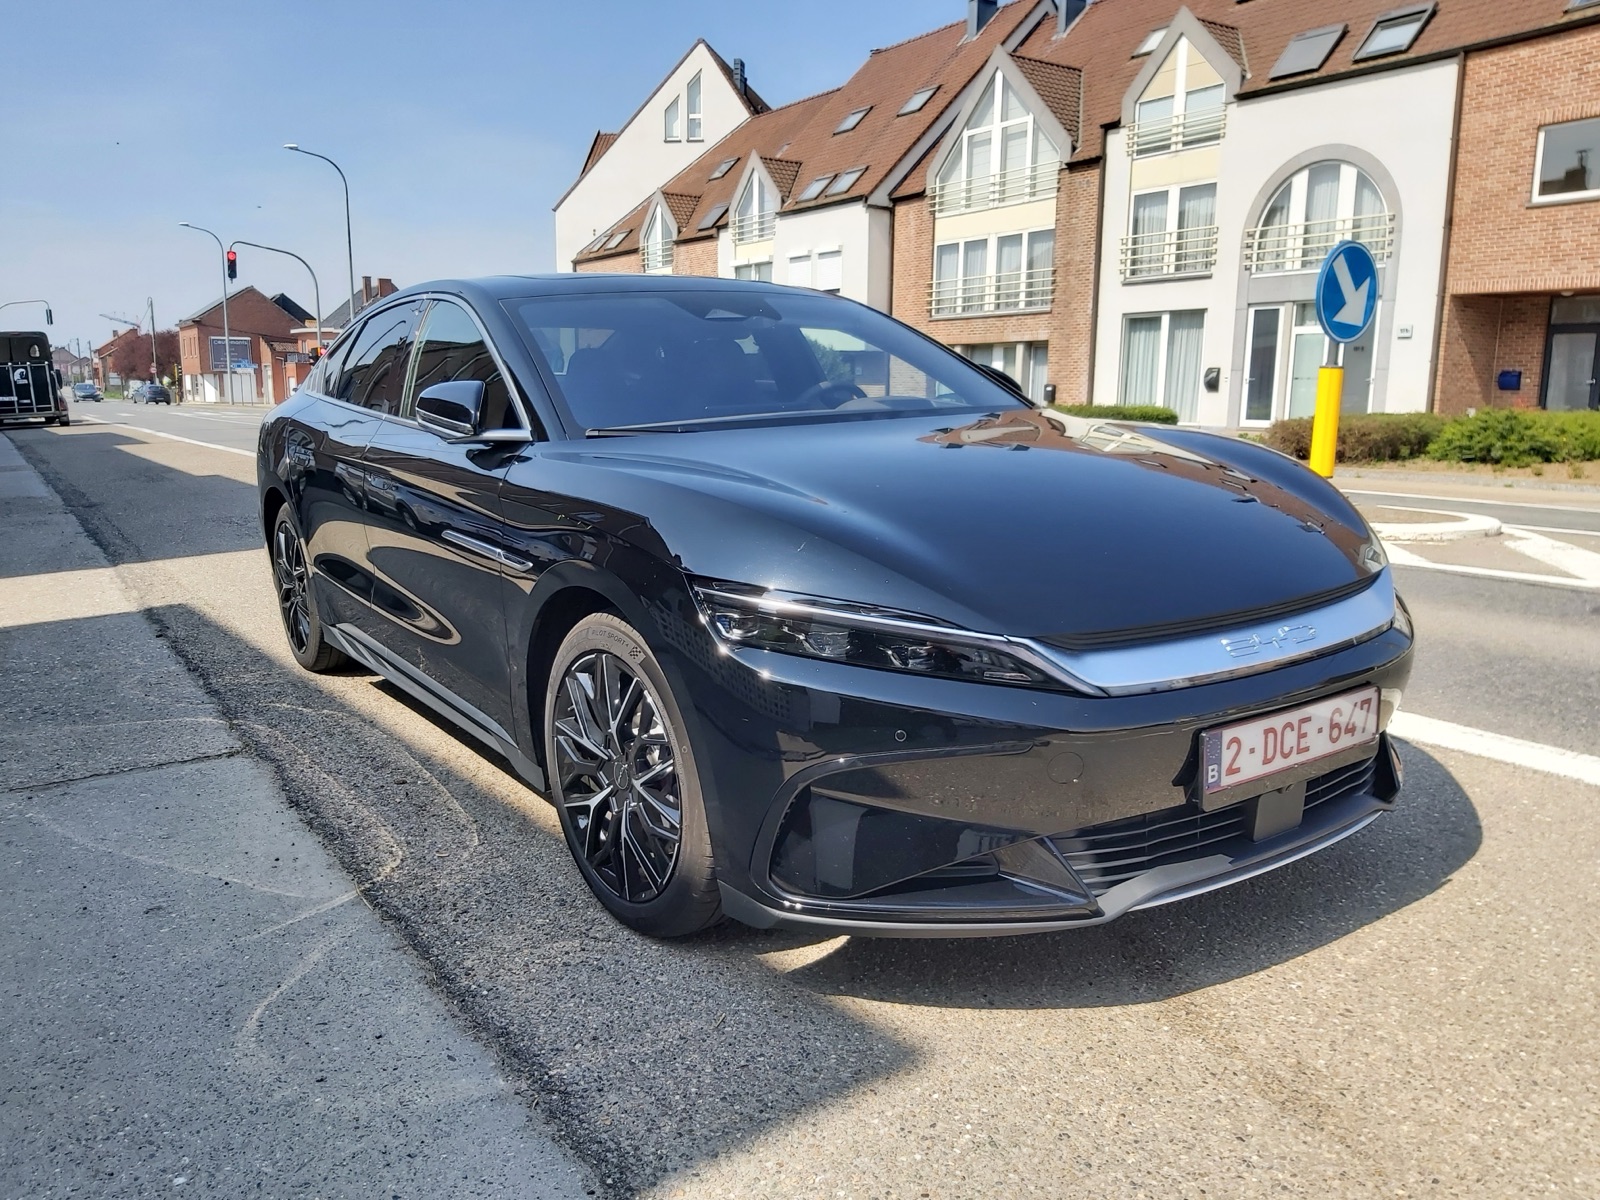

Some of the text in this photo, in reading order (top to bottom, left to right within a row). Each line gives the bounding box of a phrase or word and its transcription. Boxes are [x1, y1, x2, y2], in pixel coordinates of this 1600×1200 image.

[607, 632, 625, 645] SPORT
[1220, 625, 1316, 658] BYD
[1225, 697, 1373, 777] 2-DCE-647
[1207, 764, 1219, 784] B
